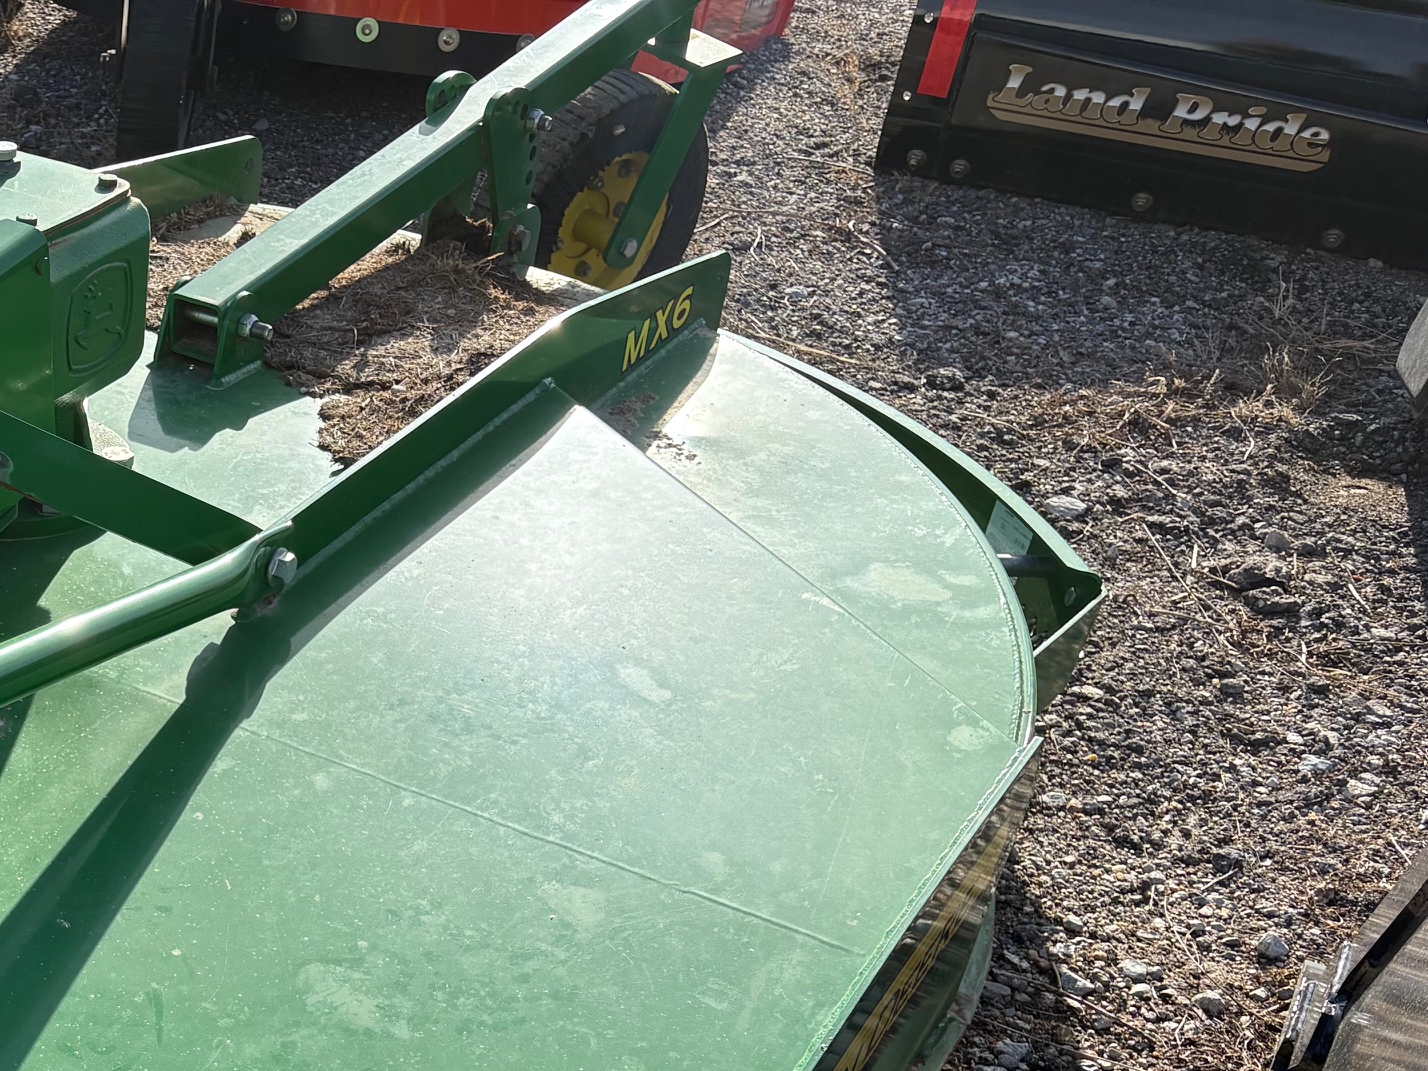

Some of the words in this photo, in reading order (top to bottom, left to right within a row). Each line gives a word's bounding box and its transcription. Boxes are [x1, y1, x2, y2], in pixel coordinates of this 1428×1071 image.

[993, 64, 1151, 125] Land
[1159, 93, 1331, 157] Pride
[621, 285, 694, 372] MX6
